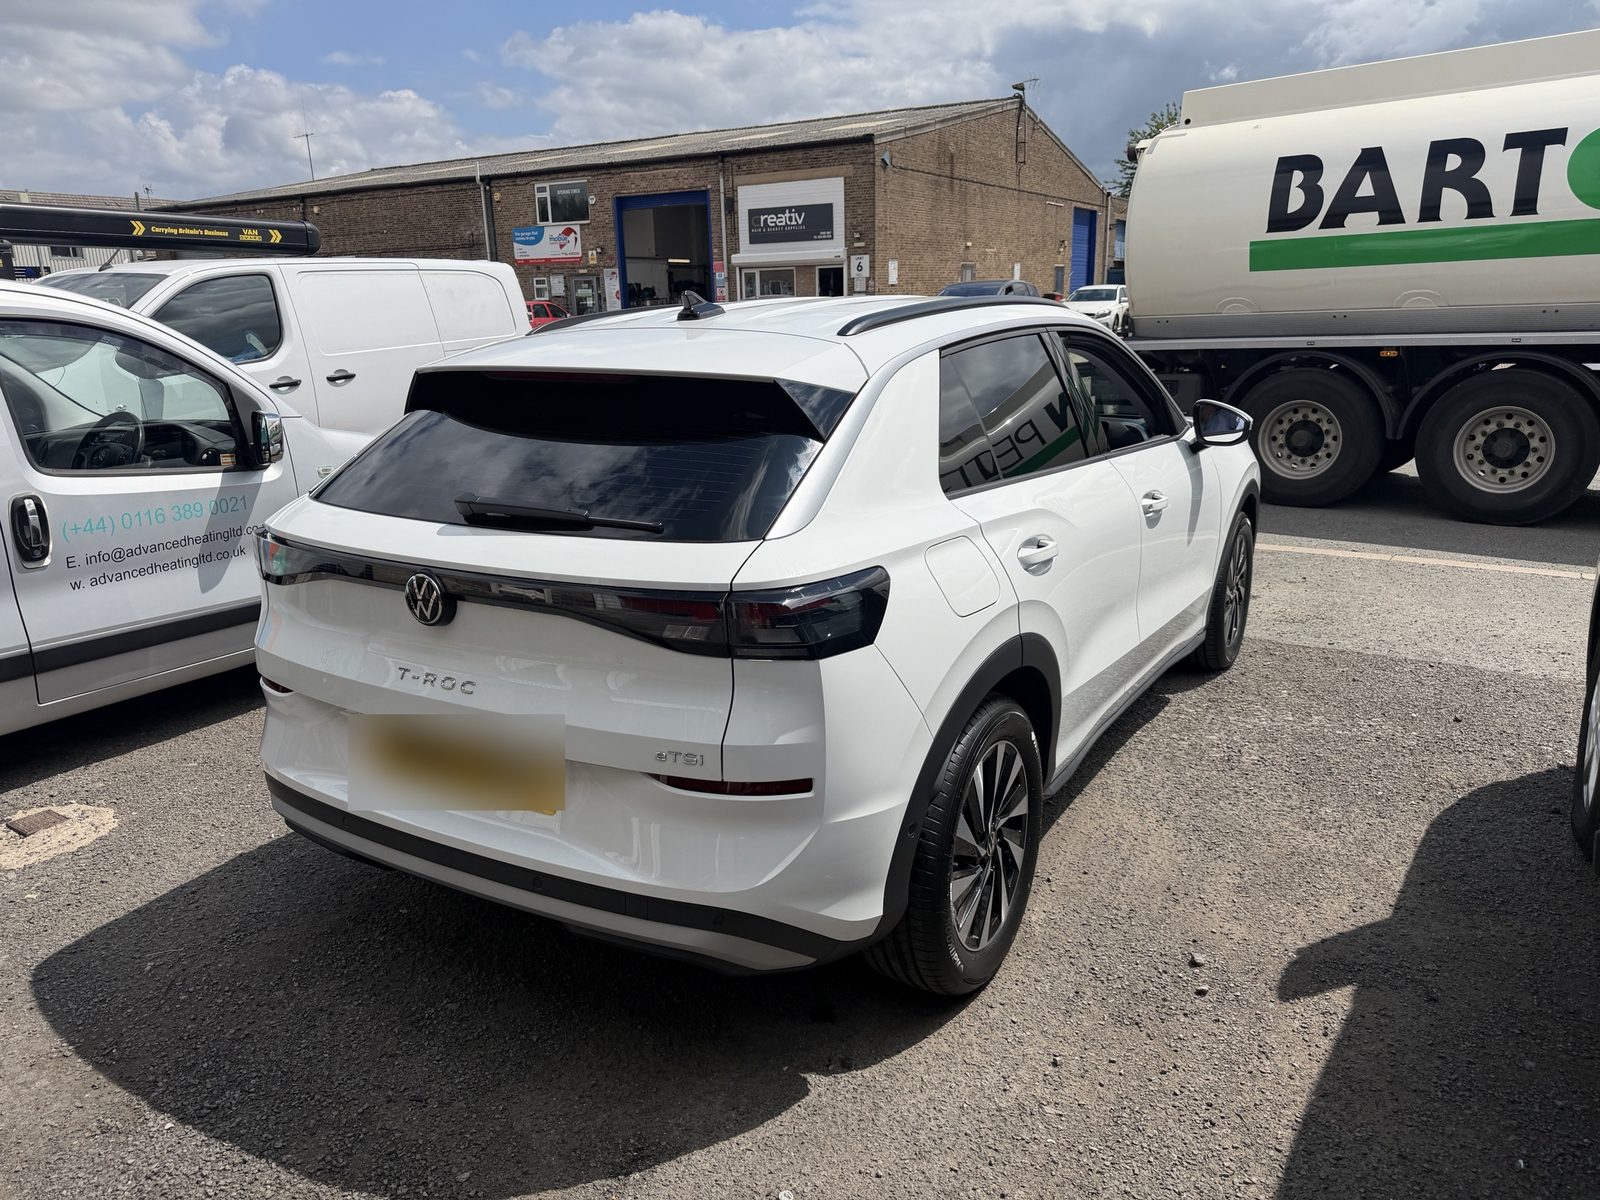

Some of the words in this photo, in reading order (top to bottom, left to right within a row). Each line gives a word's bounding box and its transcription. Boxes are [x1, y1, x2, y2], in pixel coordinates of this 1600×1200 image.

[151, 226, 178, 235] Carrying
[178, 228, 204, 236] Britain's
[204, 229, 229, 237] Business
[856, 261, 863, 272] 6
[61, 514, 117, 543] (+44)
[121, 507, 167, 531] 0116
[171, 501, 204, 522] 389
[209, 495, 248, 517] 0021
[65, 555, 82, 570] E.
[69, 579, 86, 592] w.
[89, 545, 247, 588] advancedheatingltd.co.uk
[398, 666, 477, 695] T-ROC
